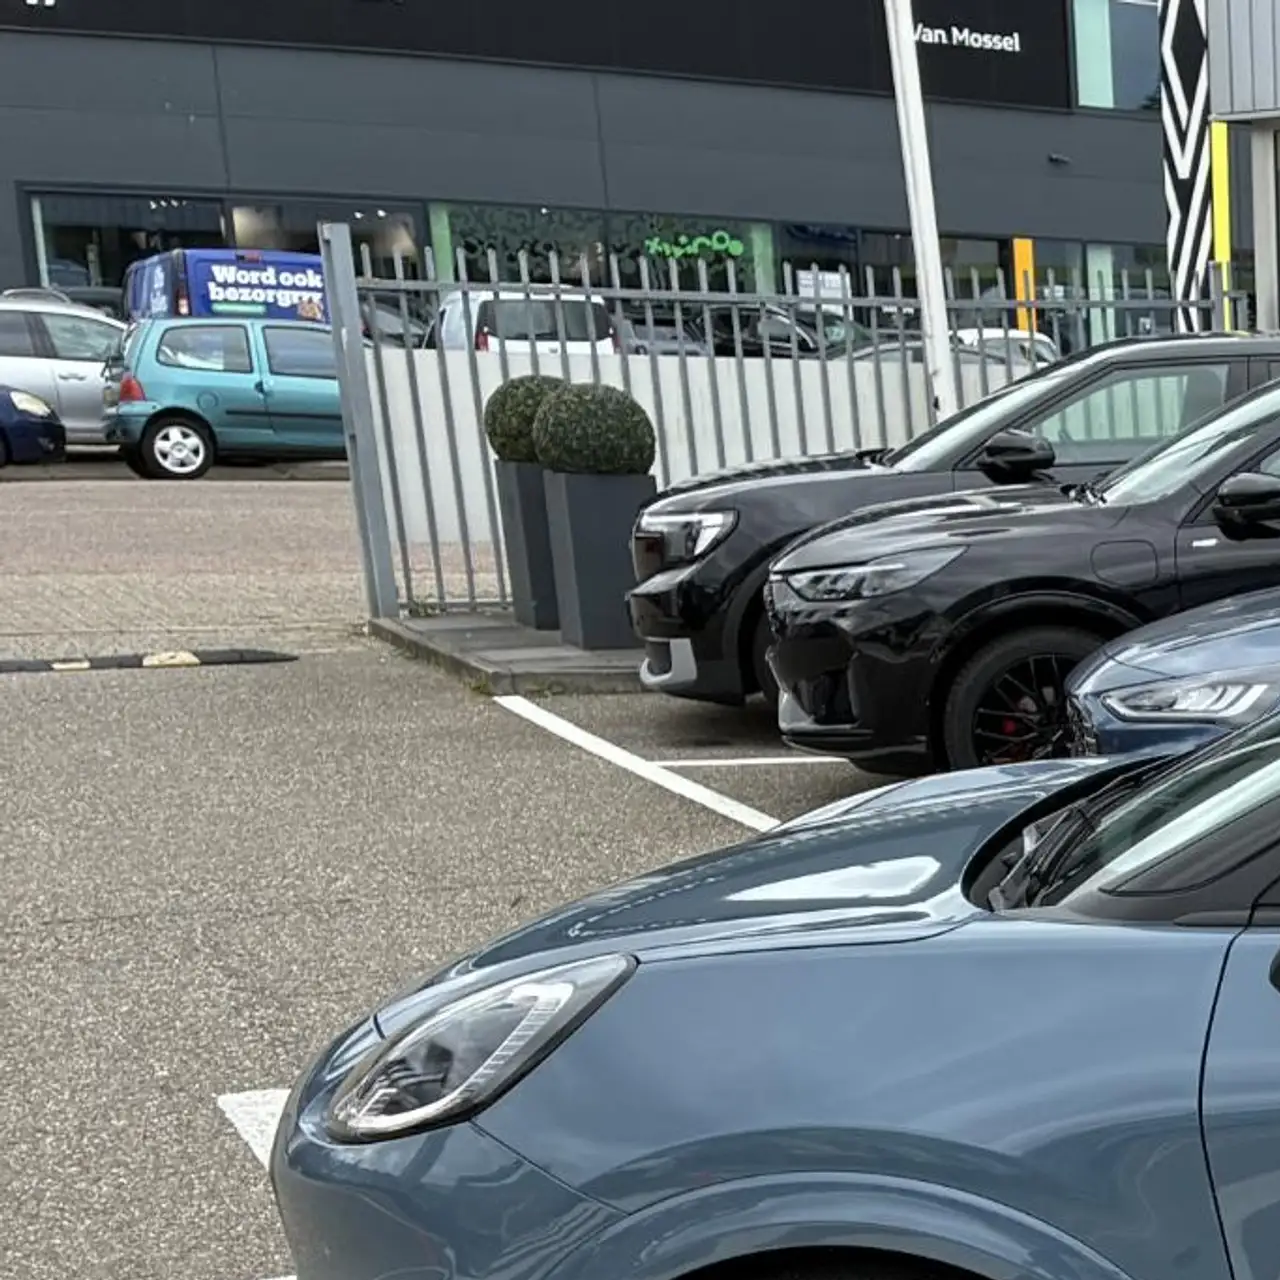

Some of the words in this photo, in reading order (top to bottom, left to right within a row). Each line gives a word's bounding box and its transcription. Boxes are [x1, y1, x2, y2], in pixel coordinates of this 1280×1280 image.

[914, 22, 948, 44] Van
[951, 26, 1020, 52] Mossel
[211, 264, 277, 285] Word
[279, 268, 323, 288] ook
